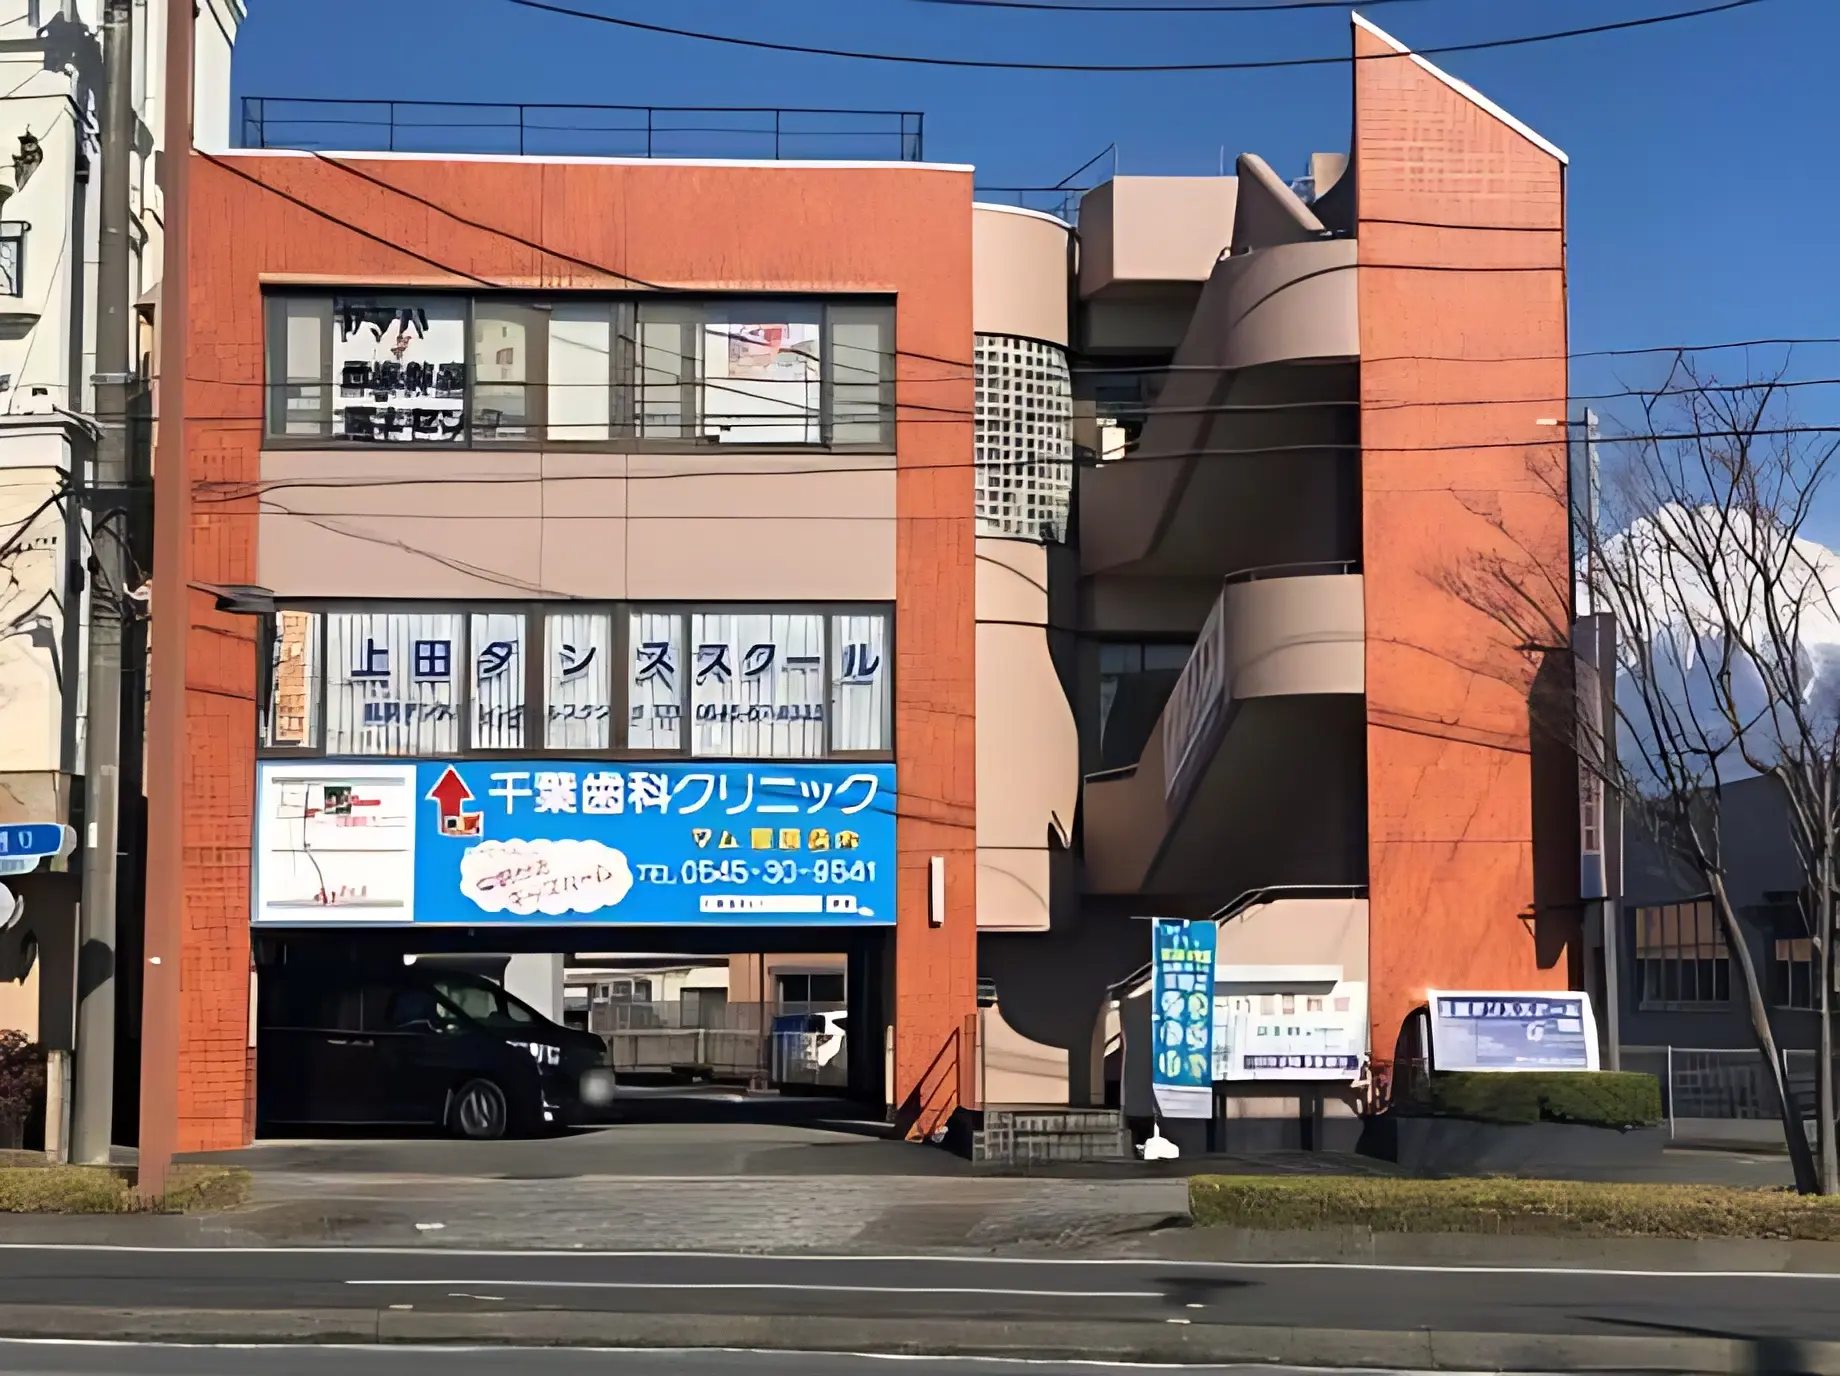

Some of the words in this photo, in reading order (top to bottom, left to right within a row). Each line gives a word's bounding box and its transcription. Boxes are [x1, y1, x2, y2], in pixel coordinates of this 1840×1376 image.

[488, 771, 878, 815] 千葉歯科クリニック
